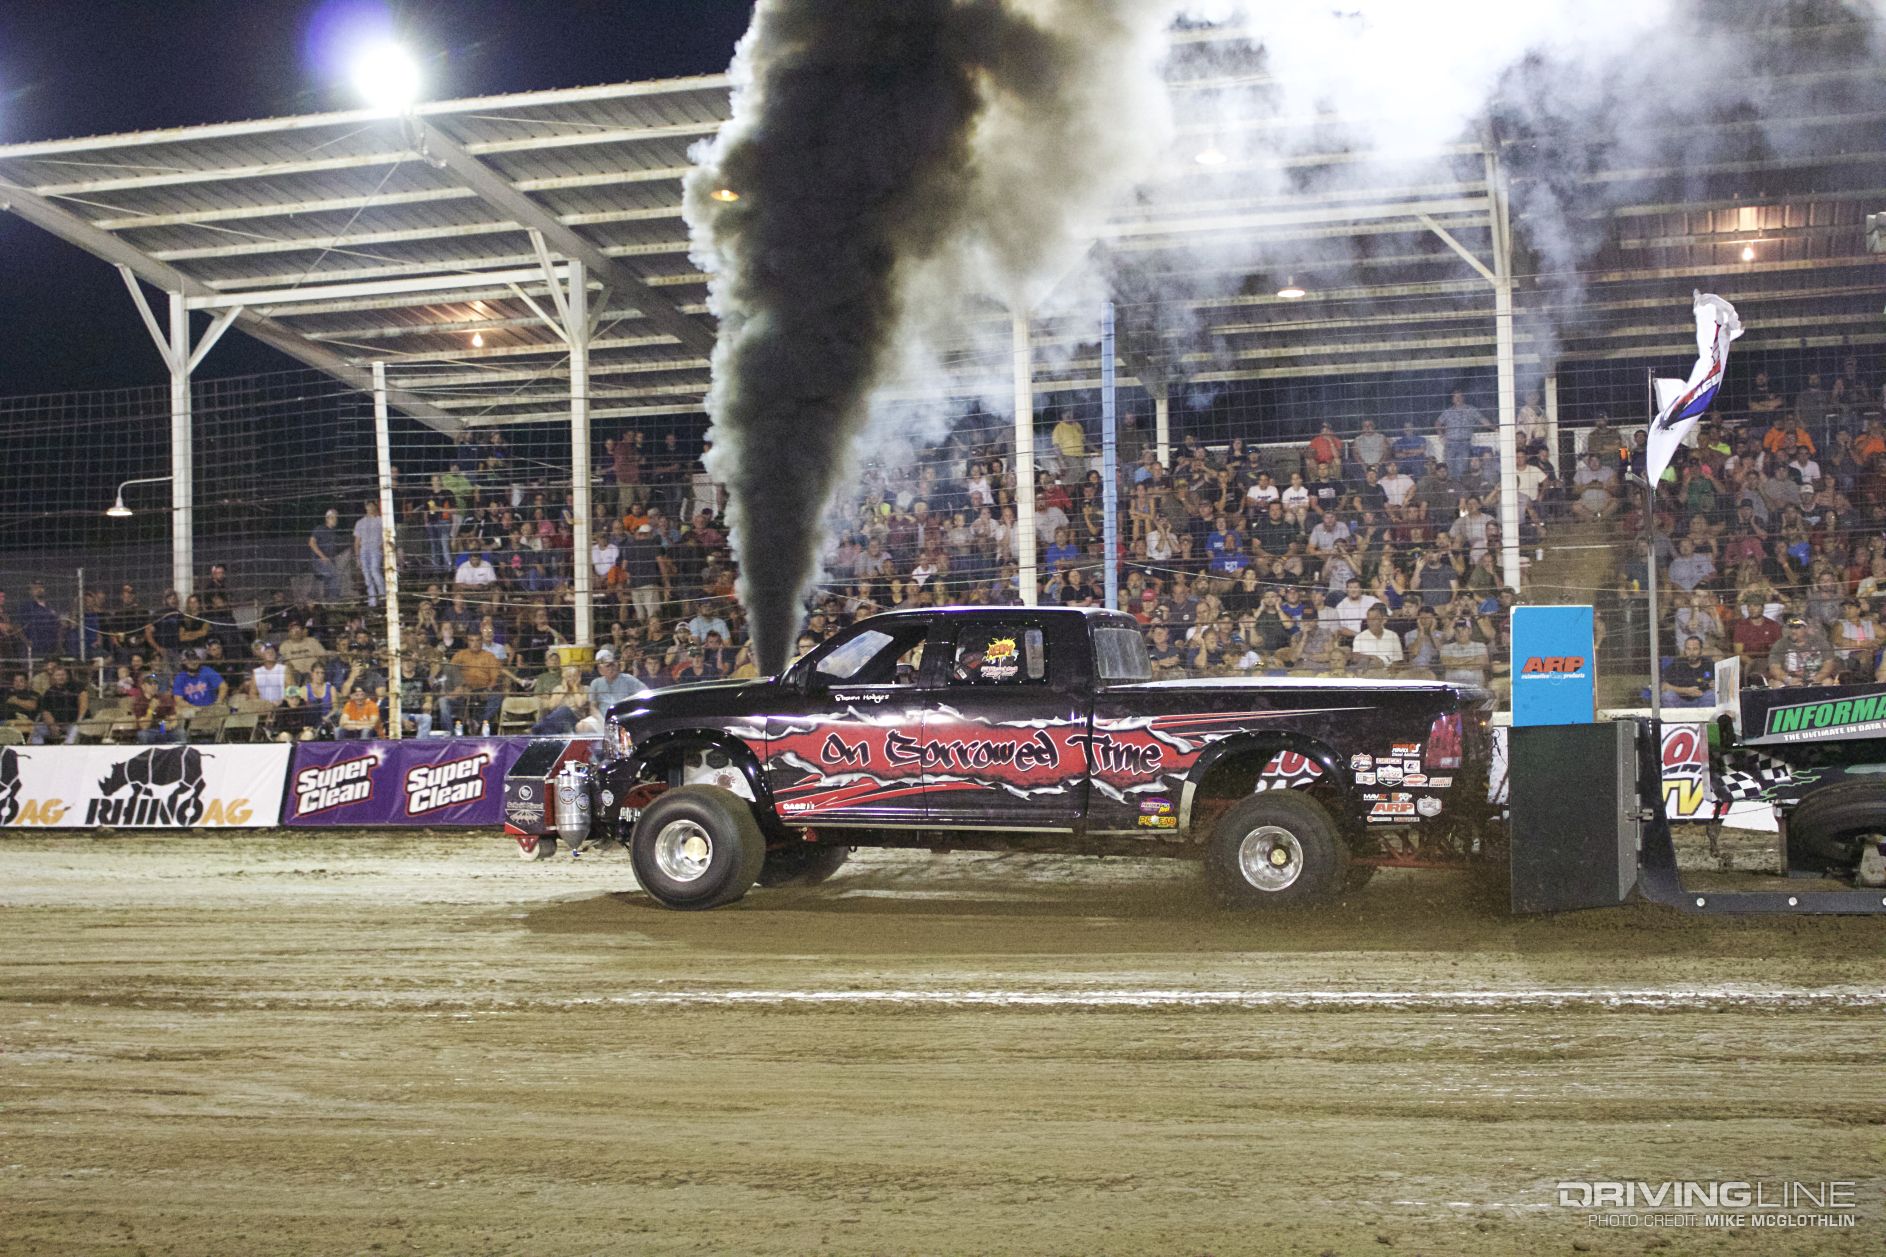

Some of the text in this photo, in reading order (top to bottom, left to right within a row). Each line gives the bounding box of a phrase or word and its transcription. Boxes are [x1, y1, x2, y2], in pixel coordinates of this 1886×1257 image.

[1521, 656, 1585, 673] ARP
[1784, 733, 1801, 741] THE
[1802, 727, 1846, 739] ULTIMATE
[1846, 724, 1857, 733] IN
[1858, 722, 1882, 731] DATA
[820, 728, 1163, 776] On Borrowed Time
[297, 757, 375, 793] Super
[407, 755, 487, 792] Super
[297, 779, 371, 814] Clean
[408, 779, 483, 813] Clean
[1374, 803, 1414, 813] ARP
